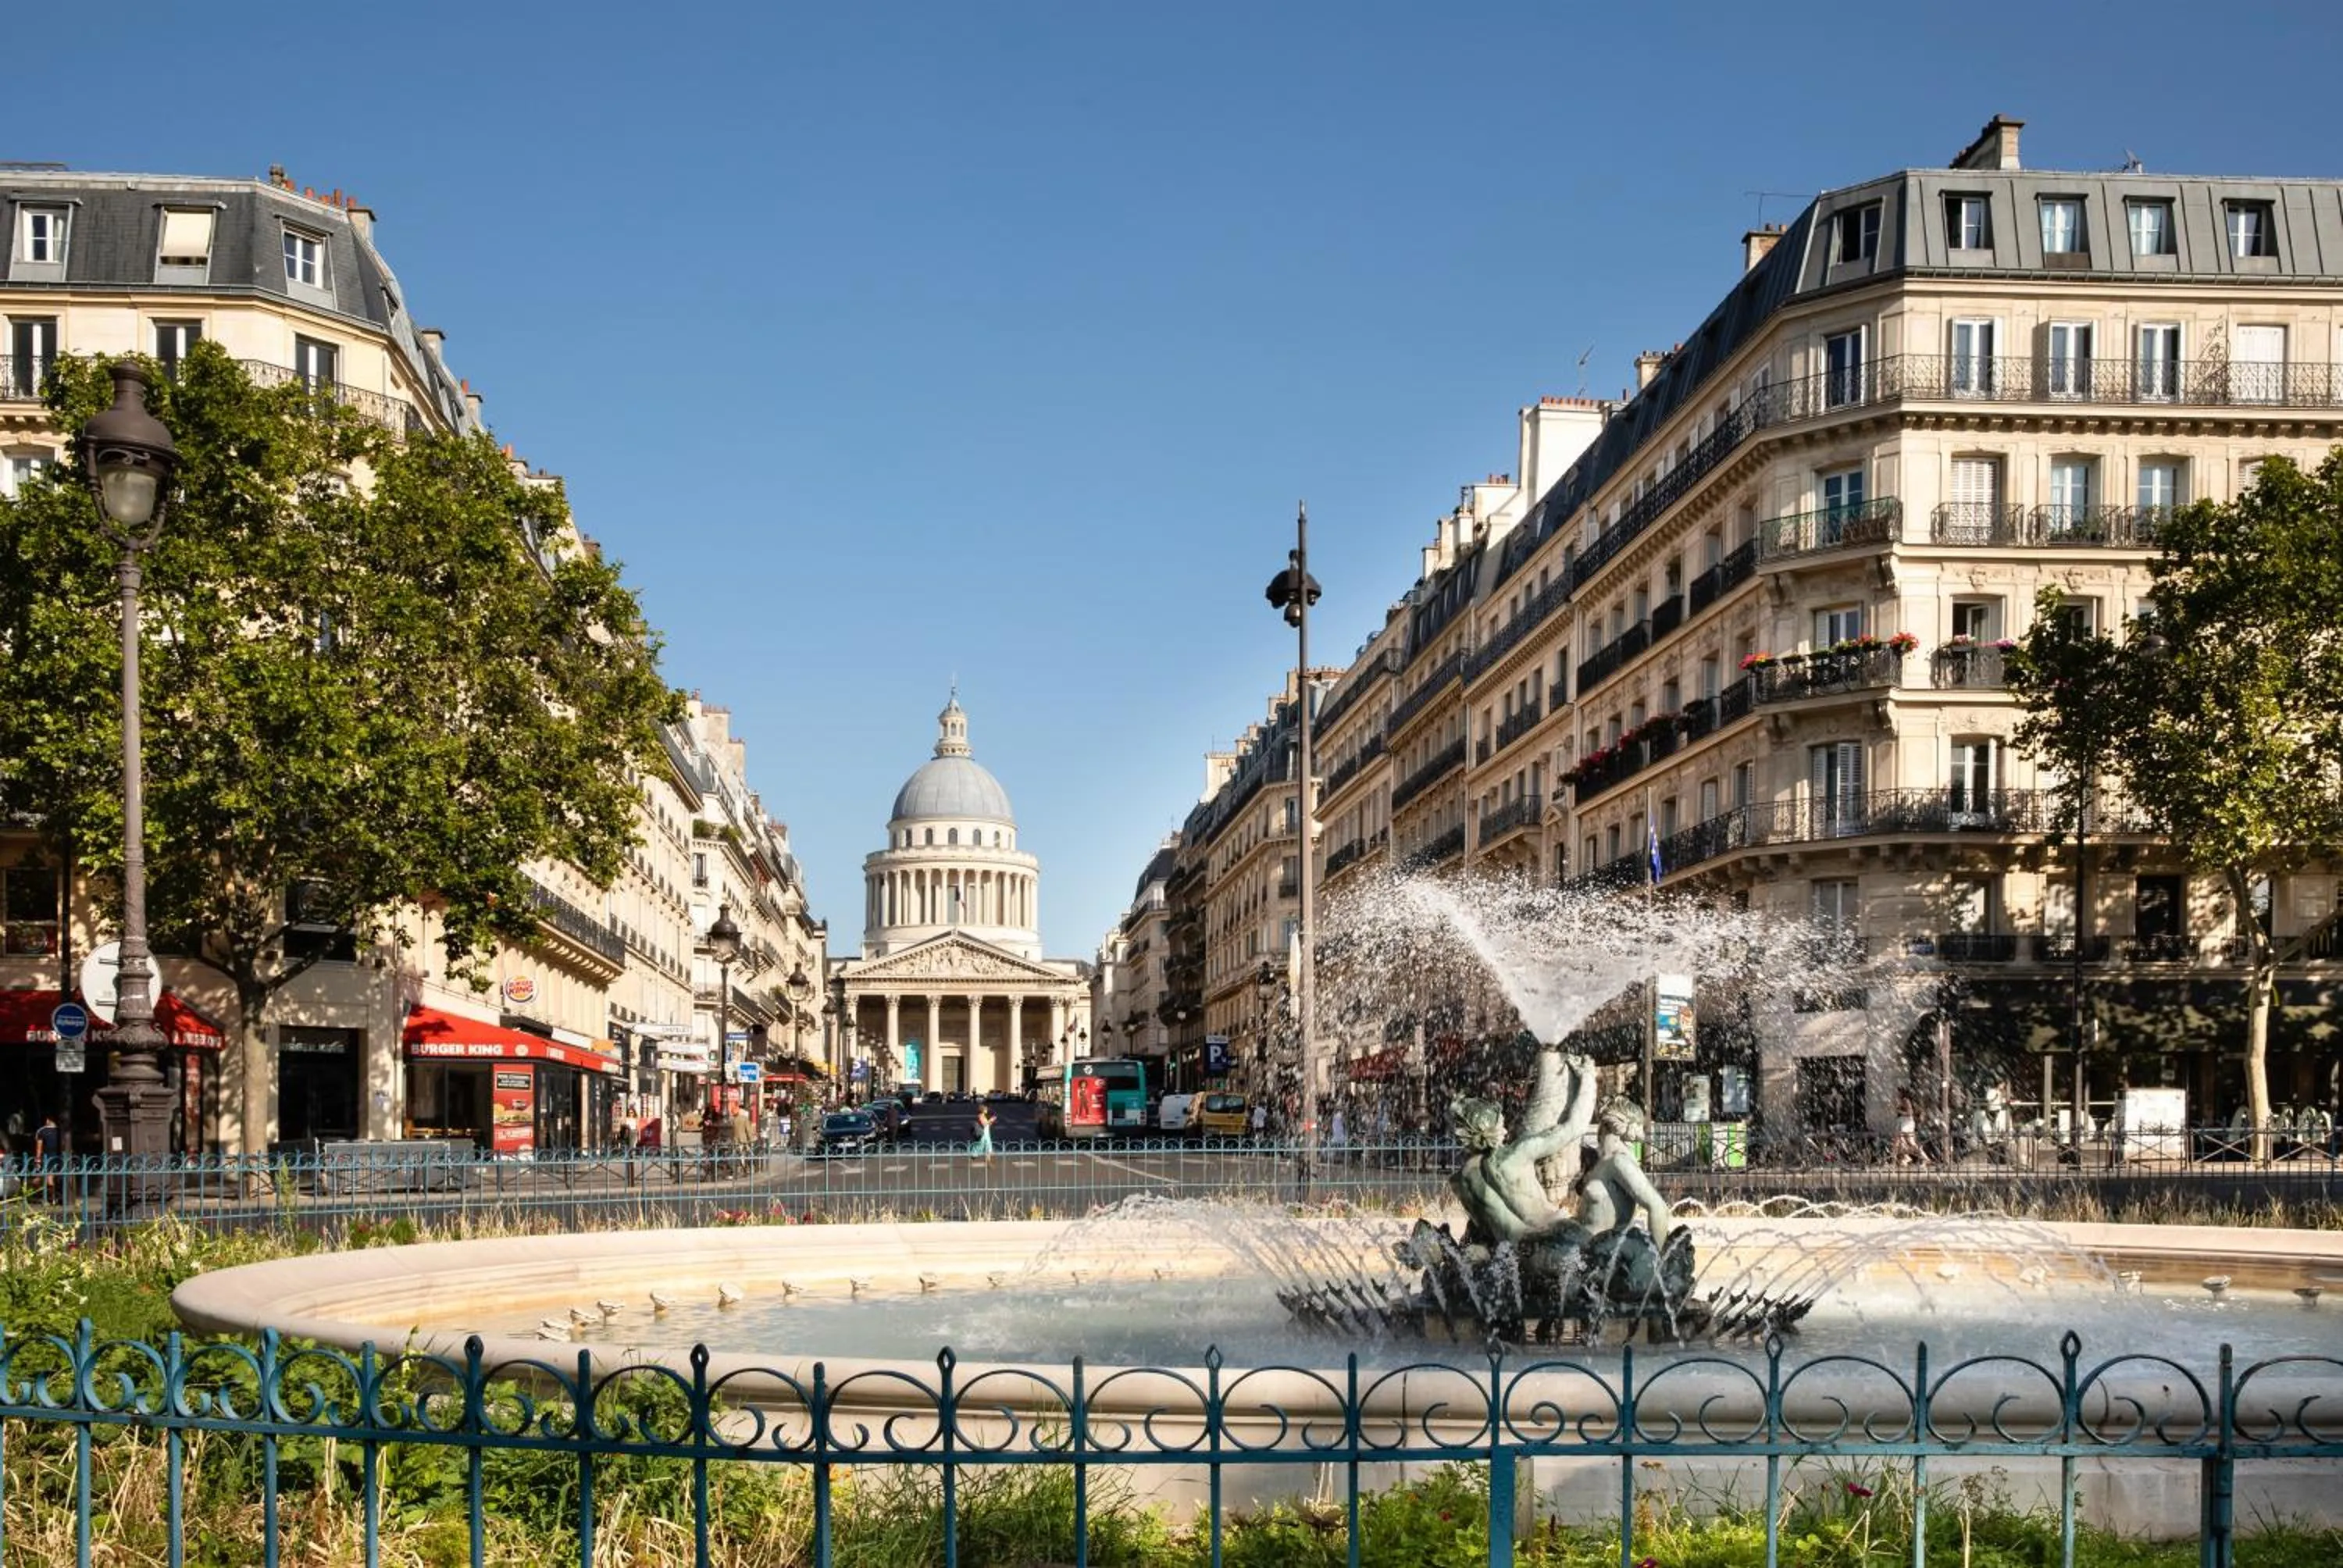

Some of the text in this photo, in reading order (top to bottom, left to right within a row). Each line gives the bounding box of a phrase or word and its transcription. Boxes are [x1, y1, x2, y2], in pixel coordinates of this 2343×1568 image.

[508, 986, 533, 995] KING
[411, 1043, 503, 1055] BURGER KING
[1210, 1045, 1222, 1062] P
